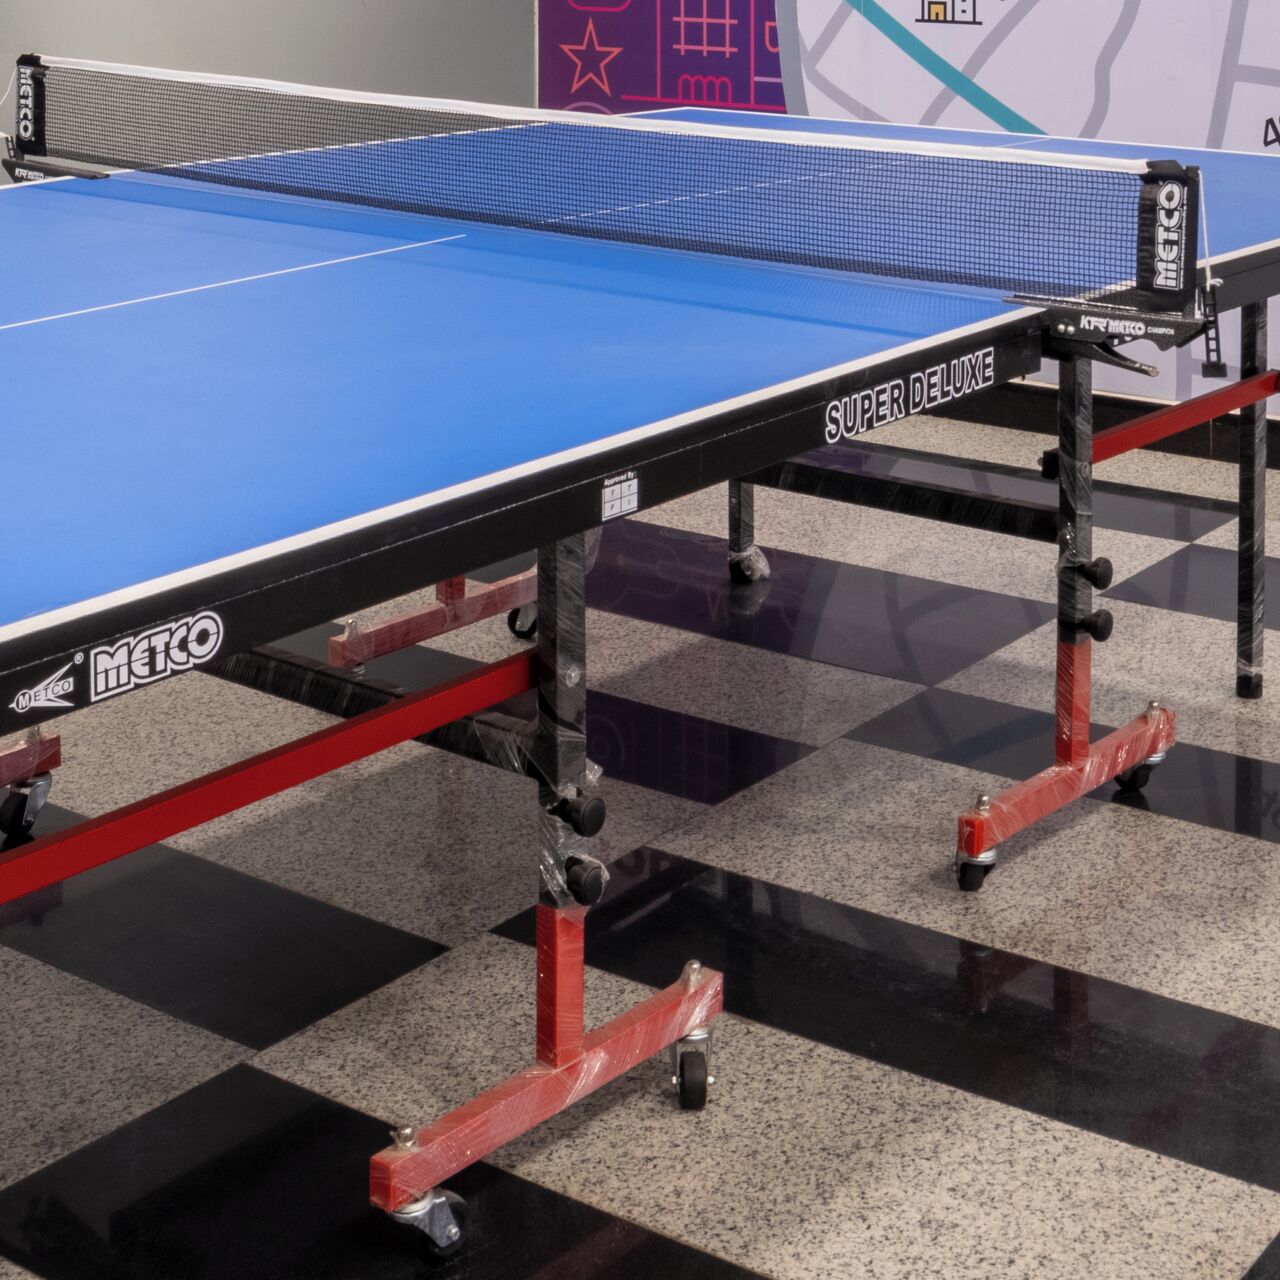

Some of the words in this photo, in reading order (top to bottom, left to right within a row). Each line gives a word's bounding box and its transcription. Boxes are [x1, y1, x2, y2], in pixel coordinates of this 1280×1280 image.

[18, 66, 34, 140] METCO
[1153, 180, 1183, 290] METCO
[1108, 319, 1146, 335] METCO
[825, 380, 904, 444] SUPER
[910, 346, 995, 413] DELUXE
[15, 678, 73, 712] METCO
[91, 611, 223, 702] METCO
